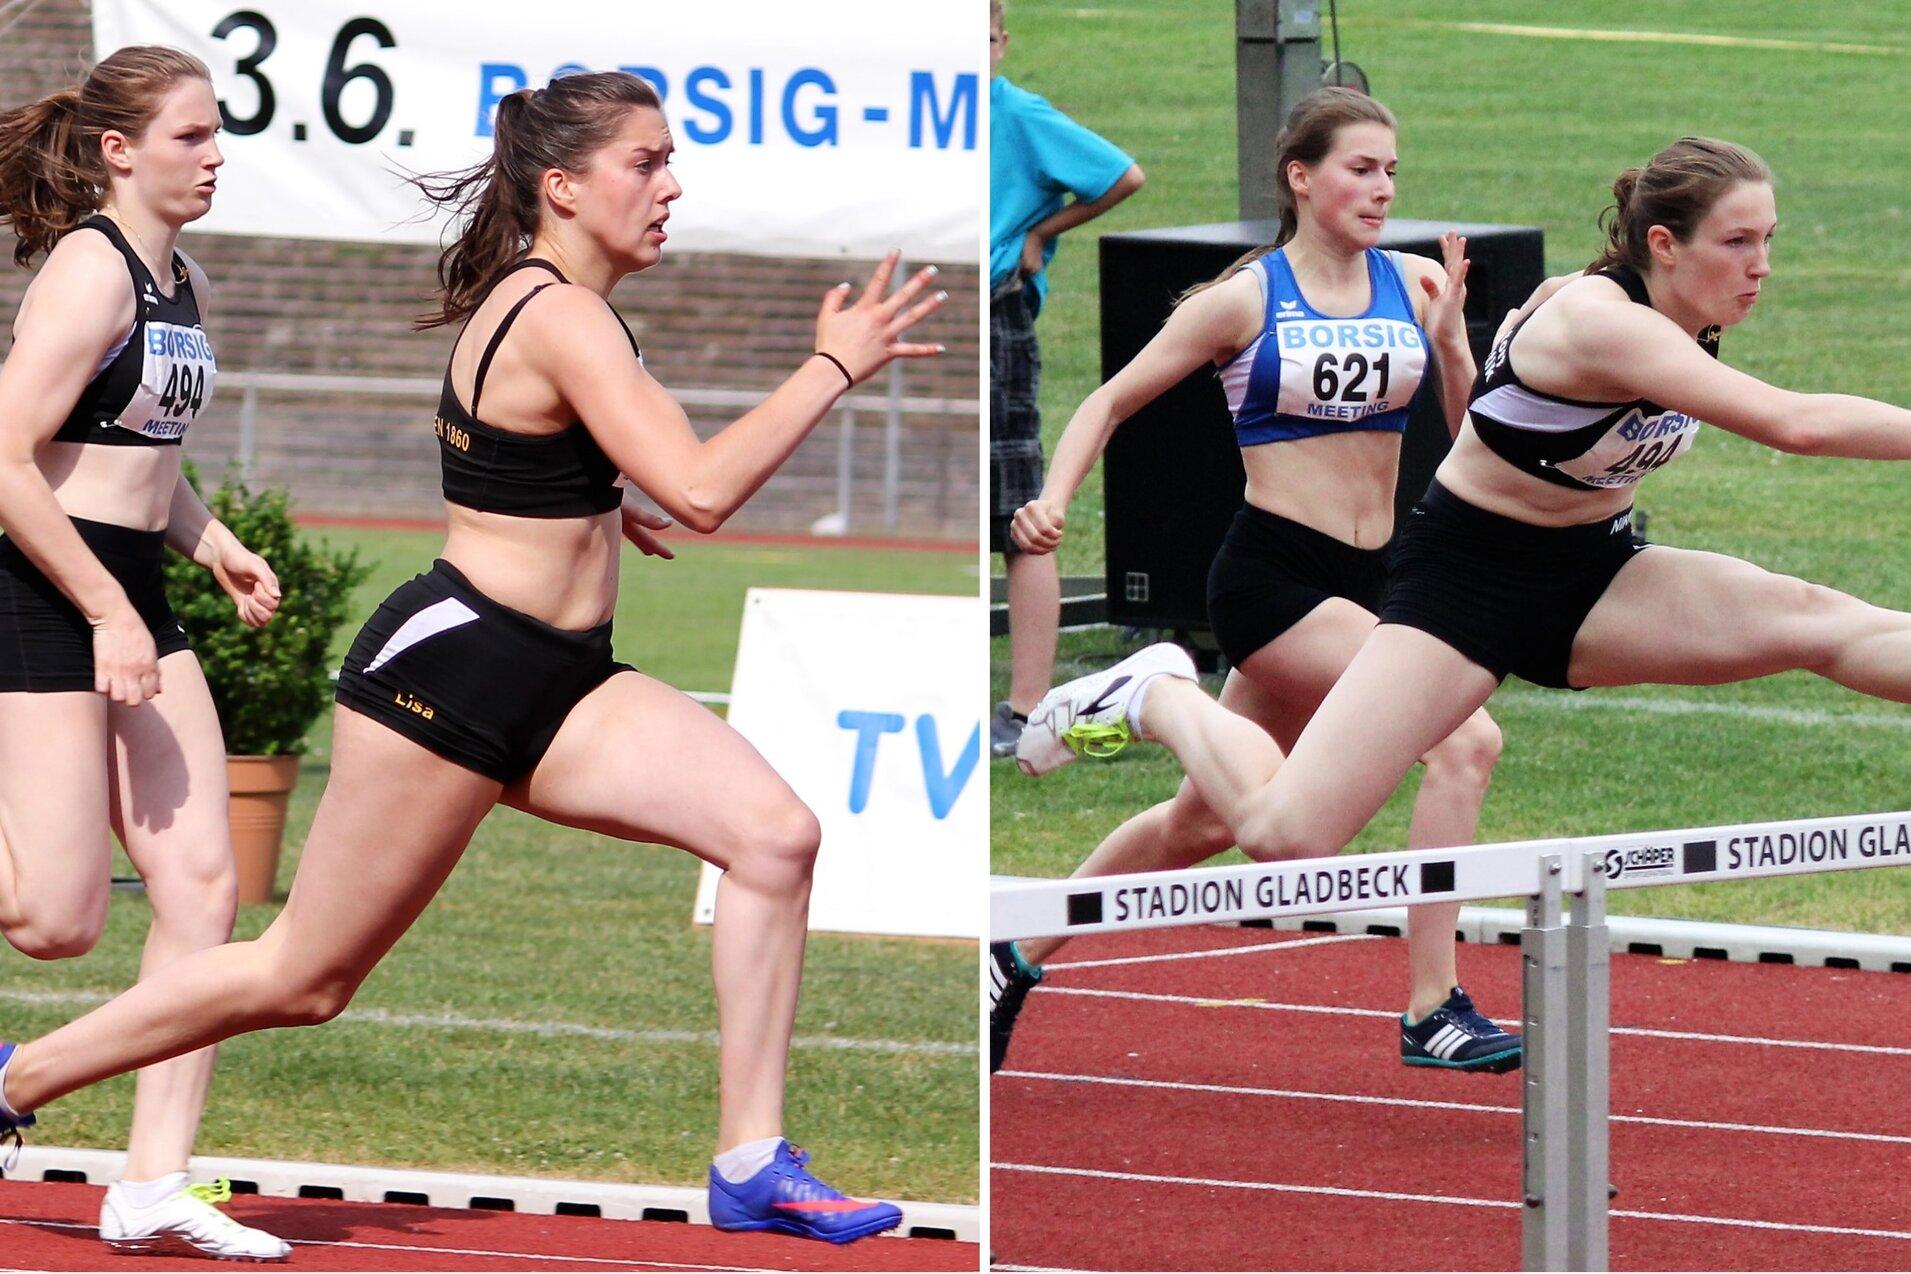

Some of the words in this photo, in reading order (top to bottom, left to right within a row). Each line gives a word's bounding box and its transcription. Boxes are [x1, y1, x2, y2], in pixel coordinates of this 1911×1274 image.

[1283, 324, 1420, 349] BORSIG
[159, 363, 205, 419] 494
[1313, 352, 1390, 402] 621
[1307, 401, 1389, 419] MEETING
[446, 422, 470, 451] 1860
[394, 693, 434, 720] Lisa
[836, 709, 981, 820] TV
[1728, 829, 1848, 869] STADION
[1859, 824, 1911, 857] GLA
[1115, 878, 1243, 921] STADION
[1255, 864, 1410, 908] GLADBECK
